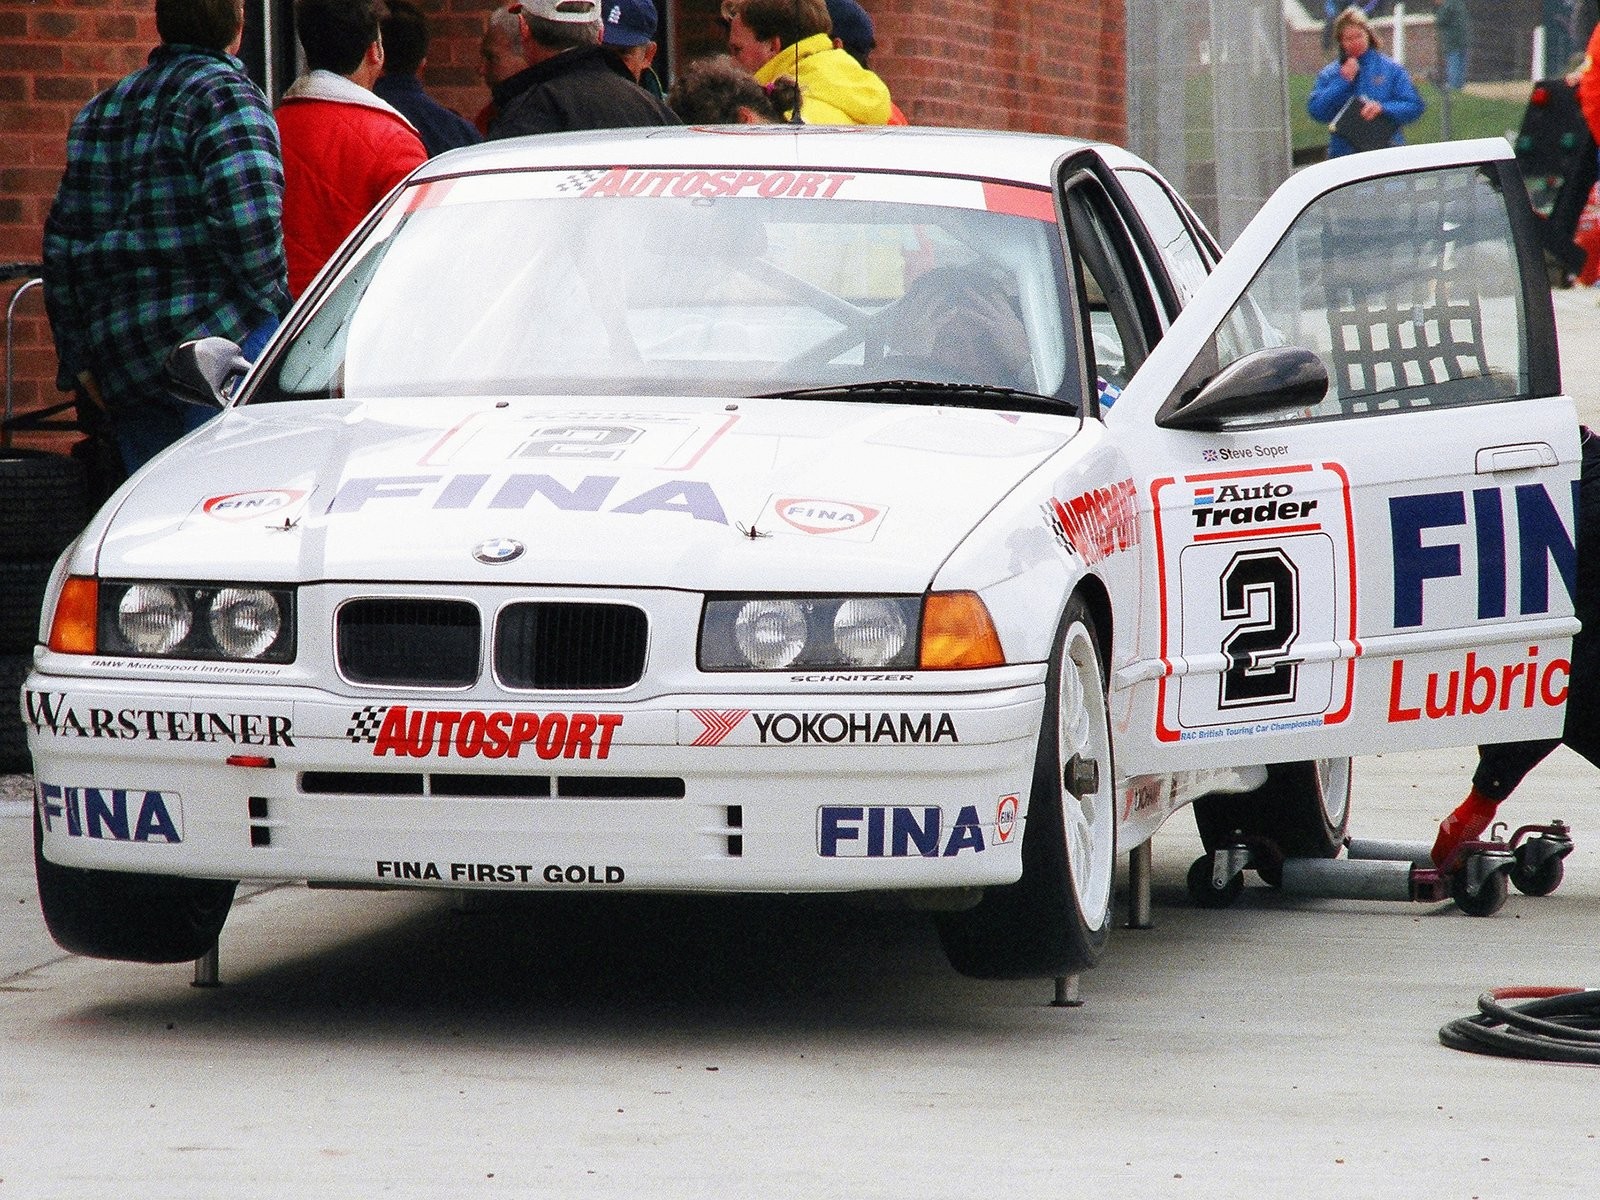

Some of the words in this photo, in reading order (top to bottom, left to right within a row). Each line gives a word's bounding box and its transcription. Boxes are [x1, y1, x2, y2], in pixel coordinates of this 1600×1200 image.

[583, 167, 855, 199] AUTOSPORT
[507, 425, 646, 461] 2
[1219, 448, 1253, 460] Steve
[1254, 445, 1289, 458] Soper
[215, 499, 281, 510] FINA
[325, 473, 729, 525] FINA
[1214, 481, 1294, 503] Auto
[786, 506, 856, 523] FINA
[1192, 499, 1318, 528] Trader
[1218, 547, 1300, 710] 2
[126, 662, 199, 672] Motorsport
[200, 666, 281, 676] International
[790, 674, 915, 683] SCHNITZER
[25, 690, 296, 748] WARSTEINER
[373, 705, 623, 760] AUTOSPORT
[752, 712, 959, 743] YOKOHAMA
[1181, 732, 1197, 741] RAC
[1199, 729, 1224, 739] British
[1226, 726, 1254, 737] Touring
[1255, 724, 1269, 734] Car
[1270, 718, 1323, 731] Championship
[40, 782, 182, 843] FINA
[820, 805, 986, 857] FINA
[376, 860, 442, 881] FINA
[451, 864, 532, 882] FIRST
[543, 865, 625, 884] GOLD
